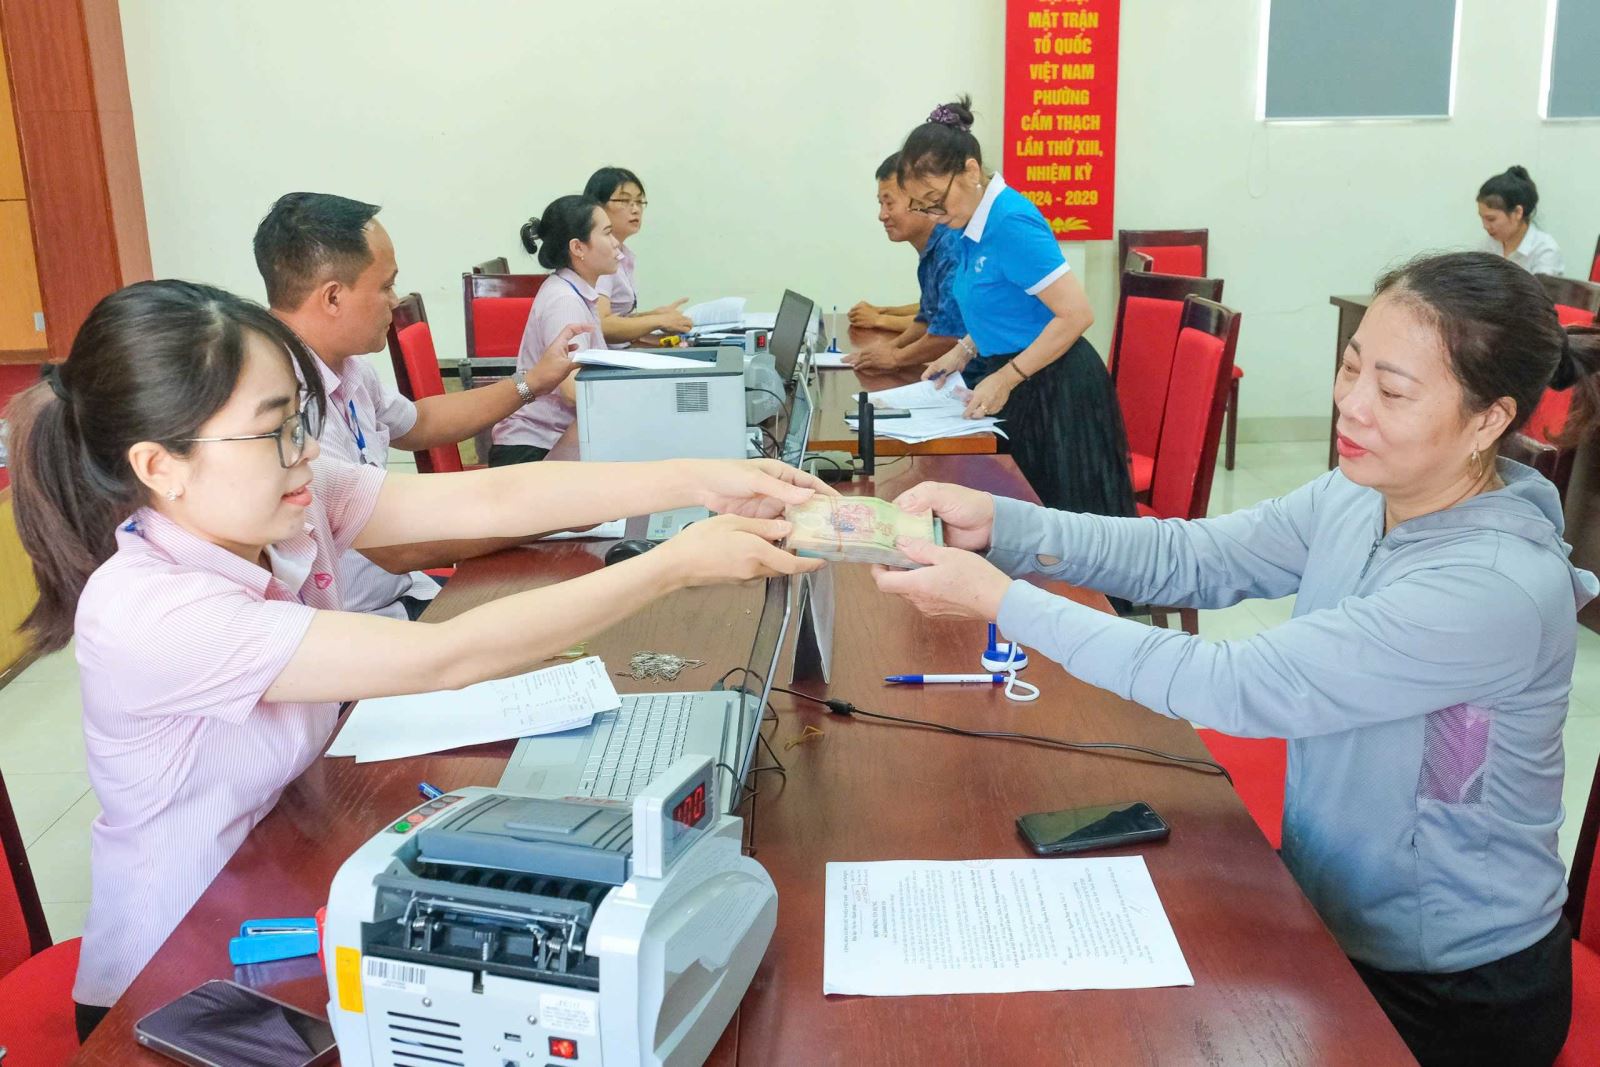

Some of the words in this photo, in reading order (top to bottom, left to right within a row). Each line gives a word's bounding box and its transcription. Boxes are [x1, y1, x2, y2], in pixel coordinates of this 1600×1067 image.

[1028, 9, 1059, 31] MẶT
[1061, 9, 1099, 31] TRẬN
[1033, 32, 1052, 55] TỔ
[1054, 32, 1092, 56] QUỐC
[1029, 61, 1060, 83] VIỆT
[1062, 64, 1095, 80] NAM
[1033, 86, 1090, 106] PHƯỜNG
[1057, 115, 1100, 134] THẠCH
[1047, 137, 1075, 157] THỨ
[1076, 140, 1104, 157] XIII,
[1026, 162, 1072, 184] NHIỆM
[1074, 162, 1093, 181] KỲ
[1065, 190, 1099, 206] 2029
